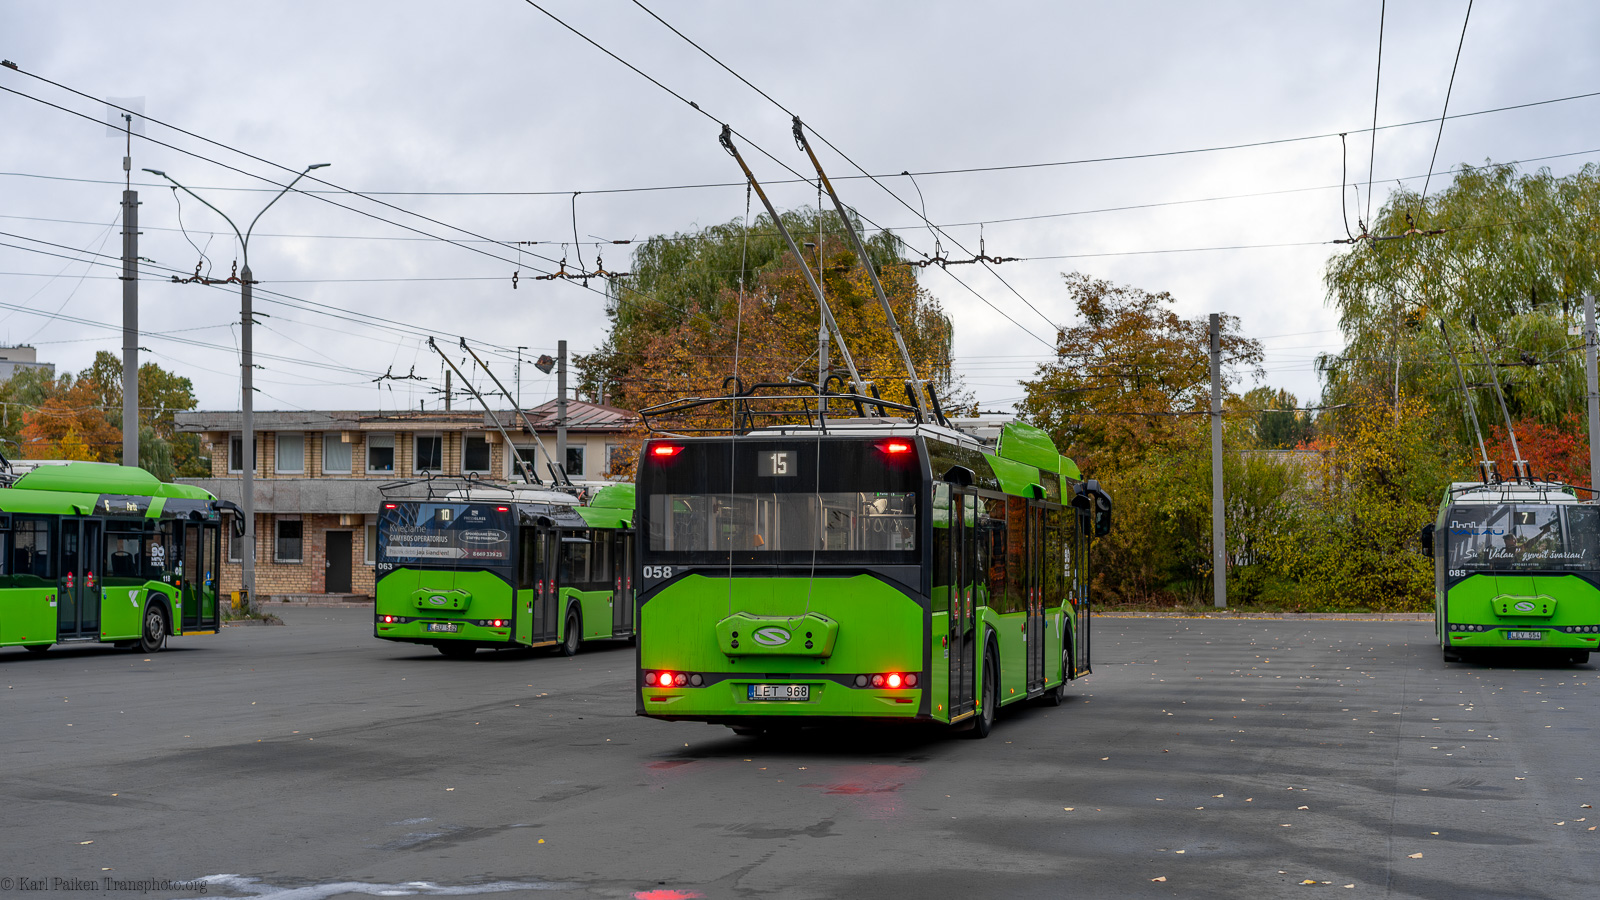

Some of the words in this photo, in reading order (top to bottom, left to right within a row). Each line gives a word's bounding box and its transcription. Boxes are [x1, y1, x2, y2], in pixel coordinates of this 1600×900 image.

[770, 452, 787, 475] 15
[104, 499, 110, 512] 6
[440, 508, 450, 521] 10
[1521, 512, 1529, 525] 7
[389, 523, 427, 533] Kviečiame
[389, 534, 413, 542] GAMYBOS
[413, 535, 448, 543] OPERATORIUS
[1464, 549, 1478, 559] Su
[1549, 549, 1587, 559] švariau!
[642, 565, 673, 579] 058
[755, 686, 779, 697] LET
[786, 686, 807, 697] 968
